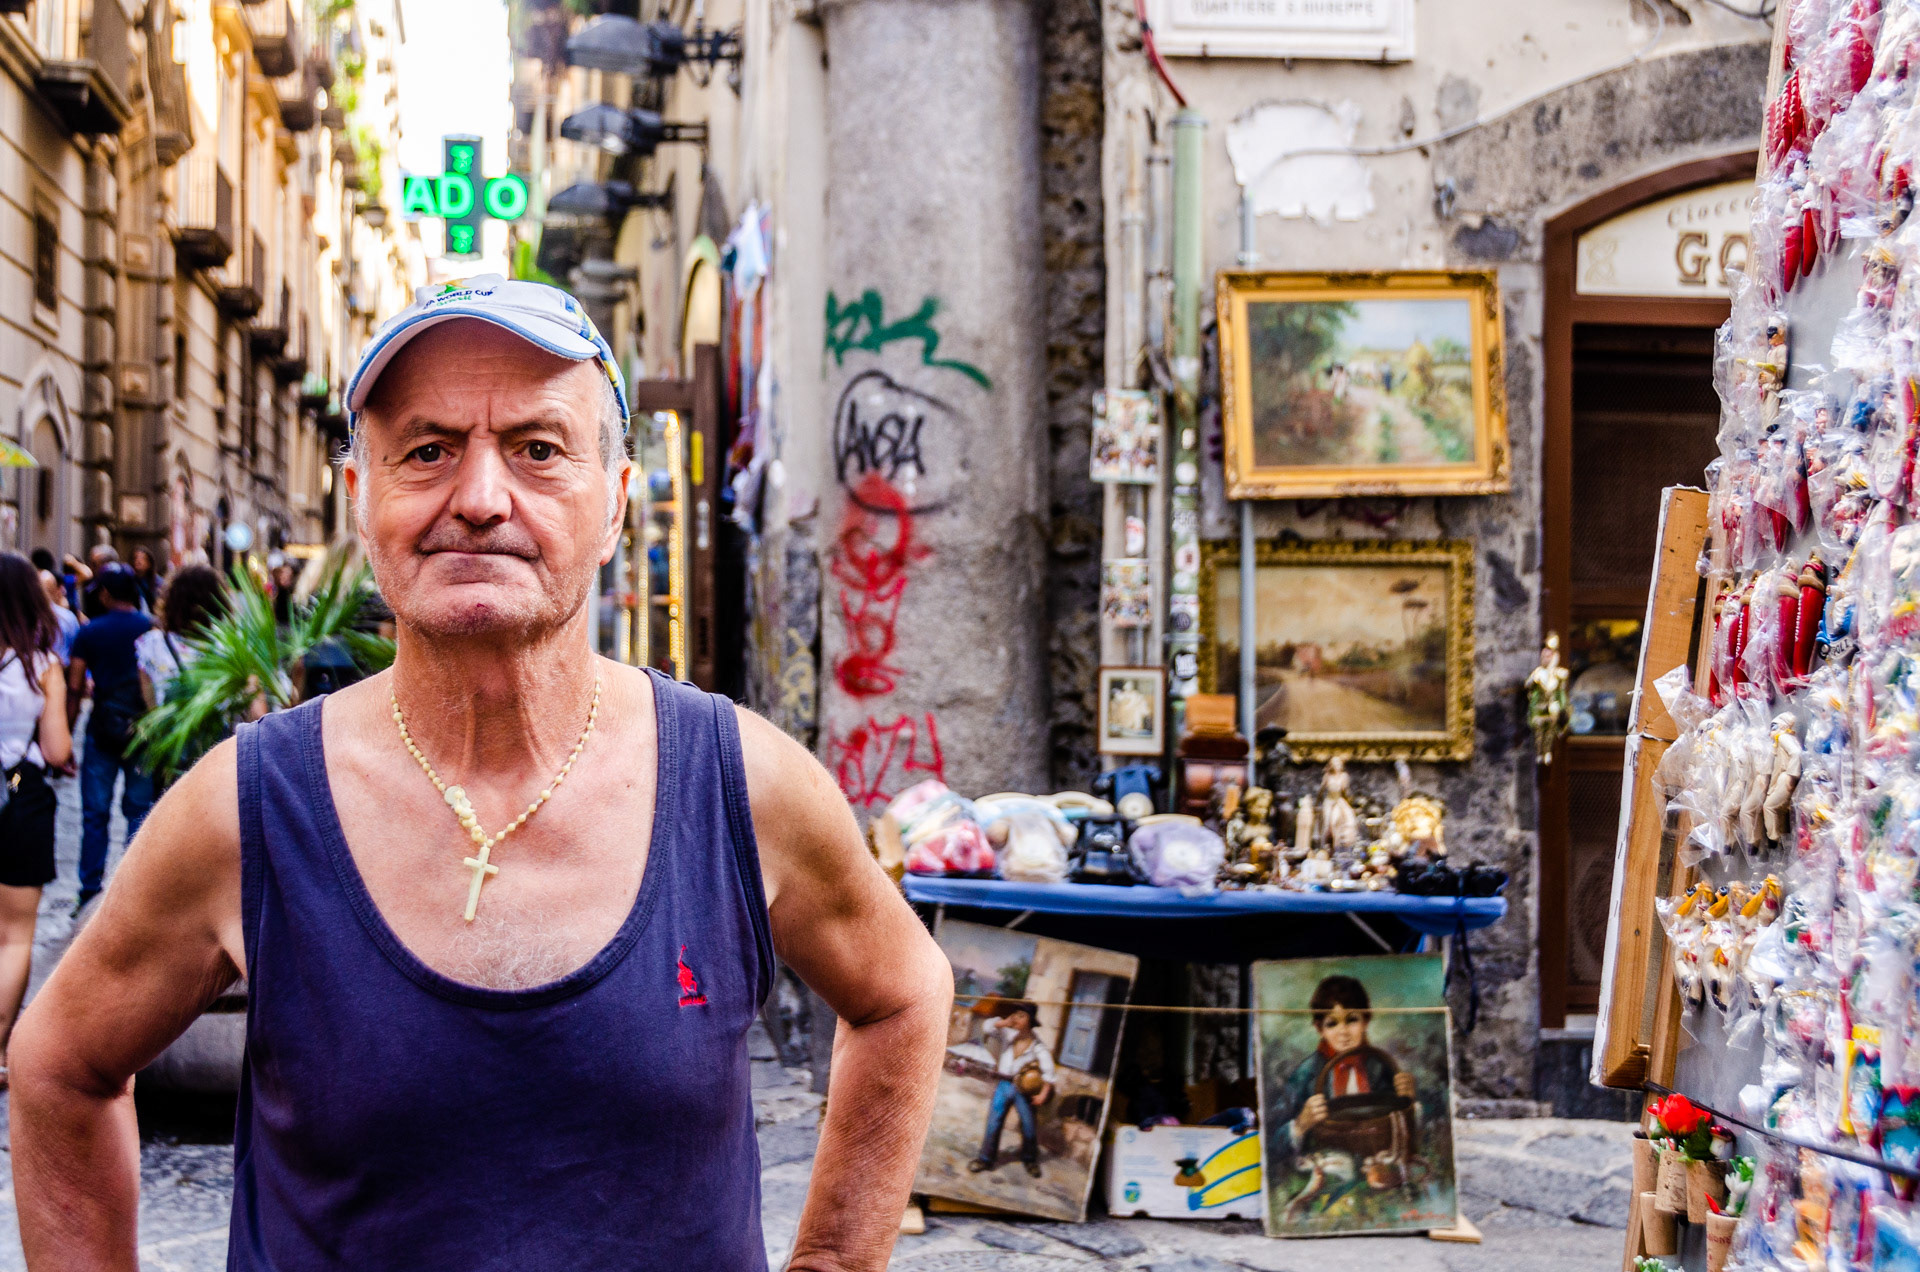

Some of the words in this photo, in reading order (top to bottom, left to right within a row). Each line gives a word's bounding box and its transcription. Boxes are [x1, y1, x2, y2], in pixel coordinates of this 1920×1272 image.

[1667, 198, 1752, 229] Ciocco
[437, 289, 473, 302] WORLD
[475, 289, 494, 297] CUP
